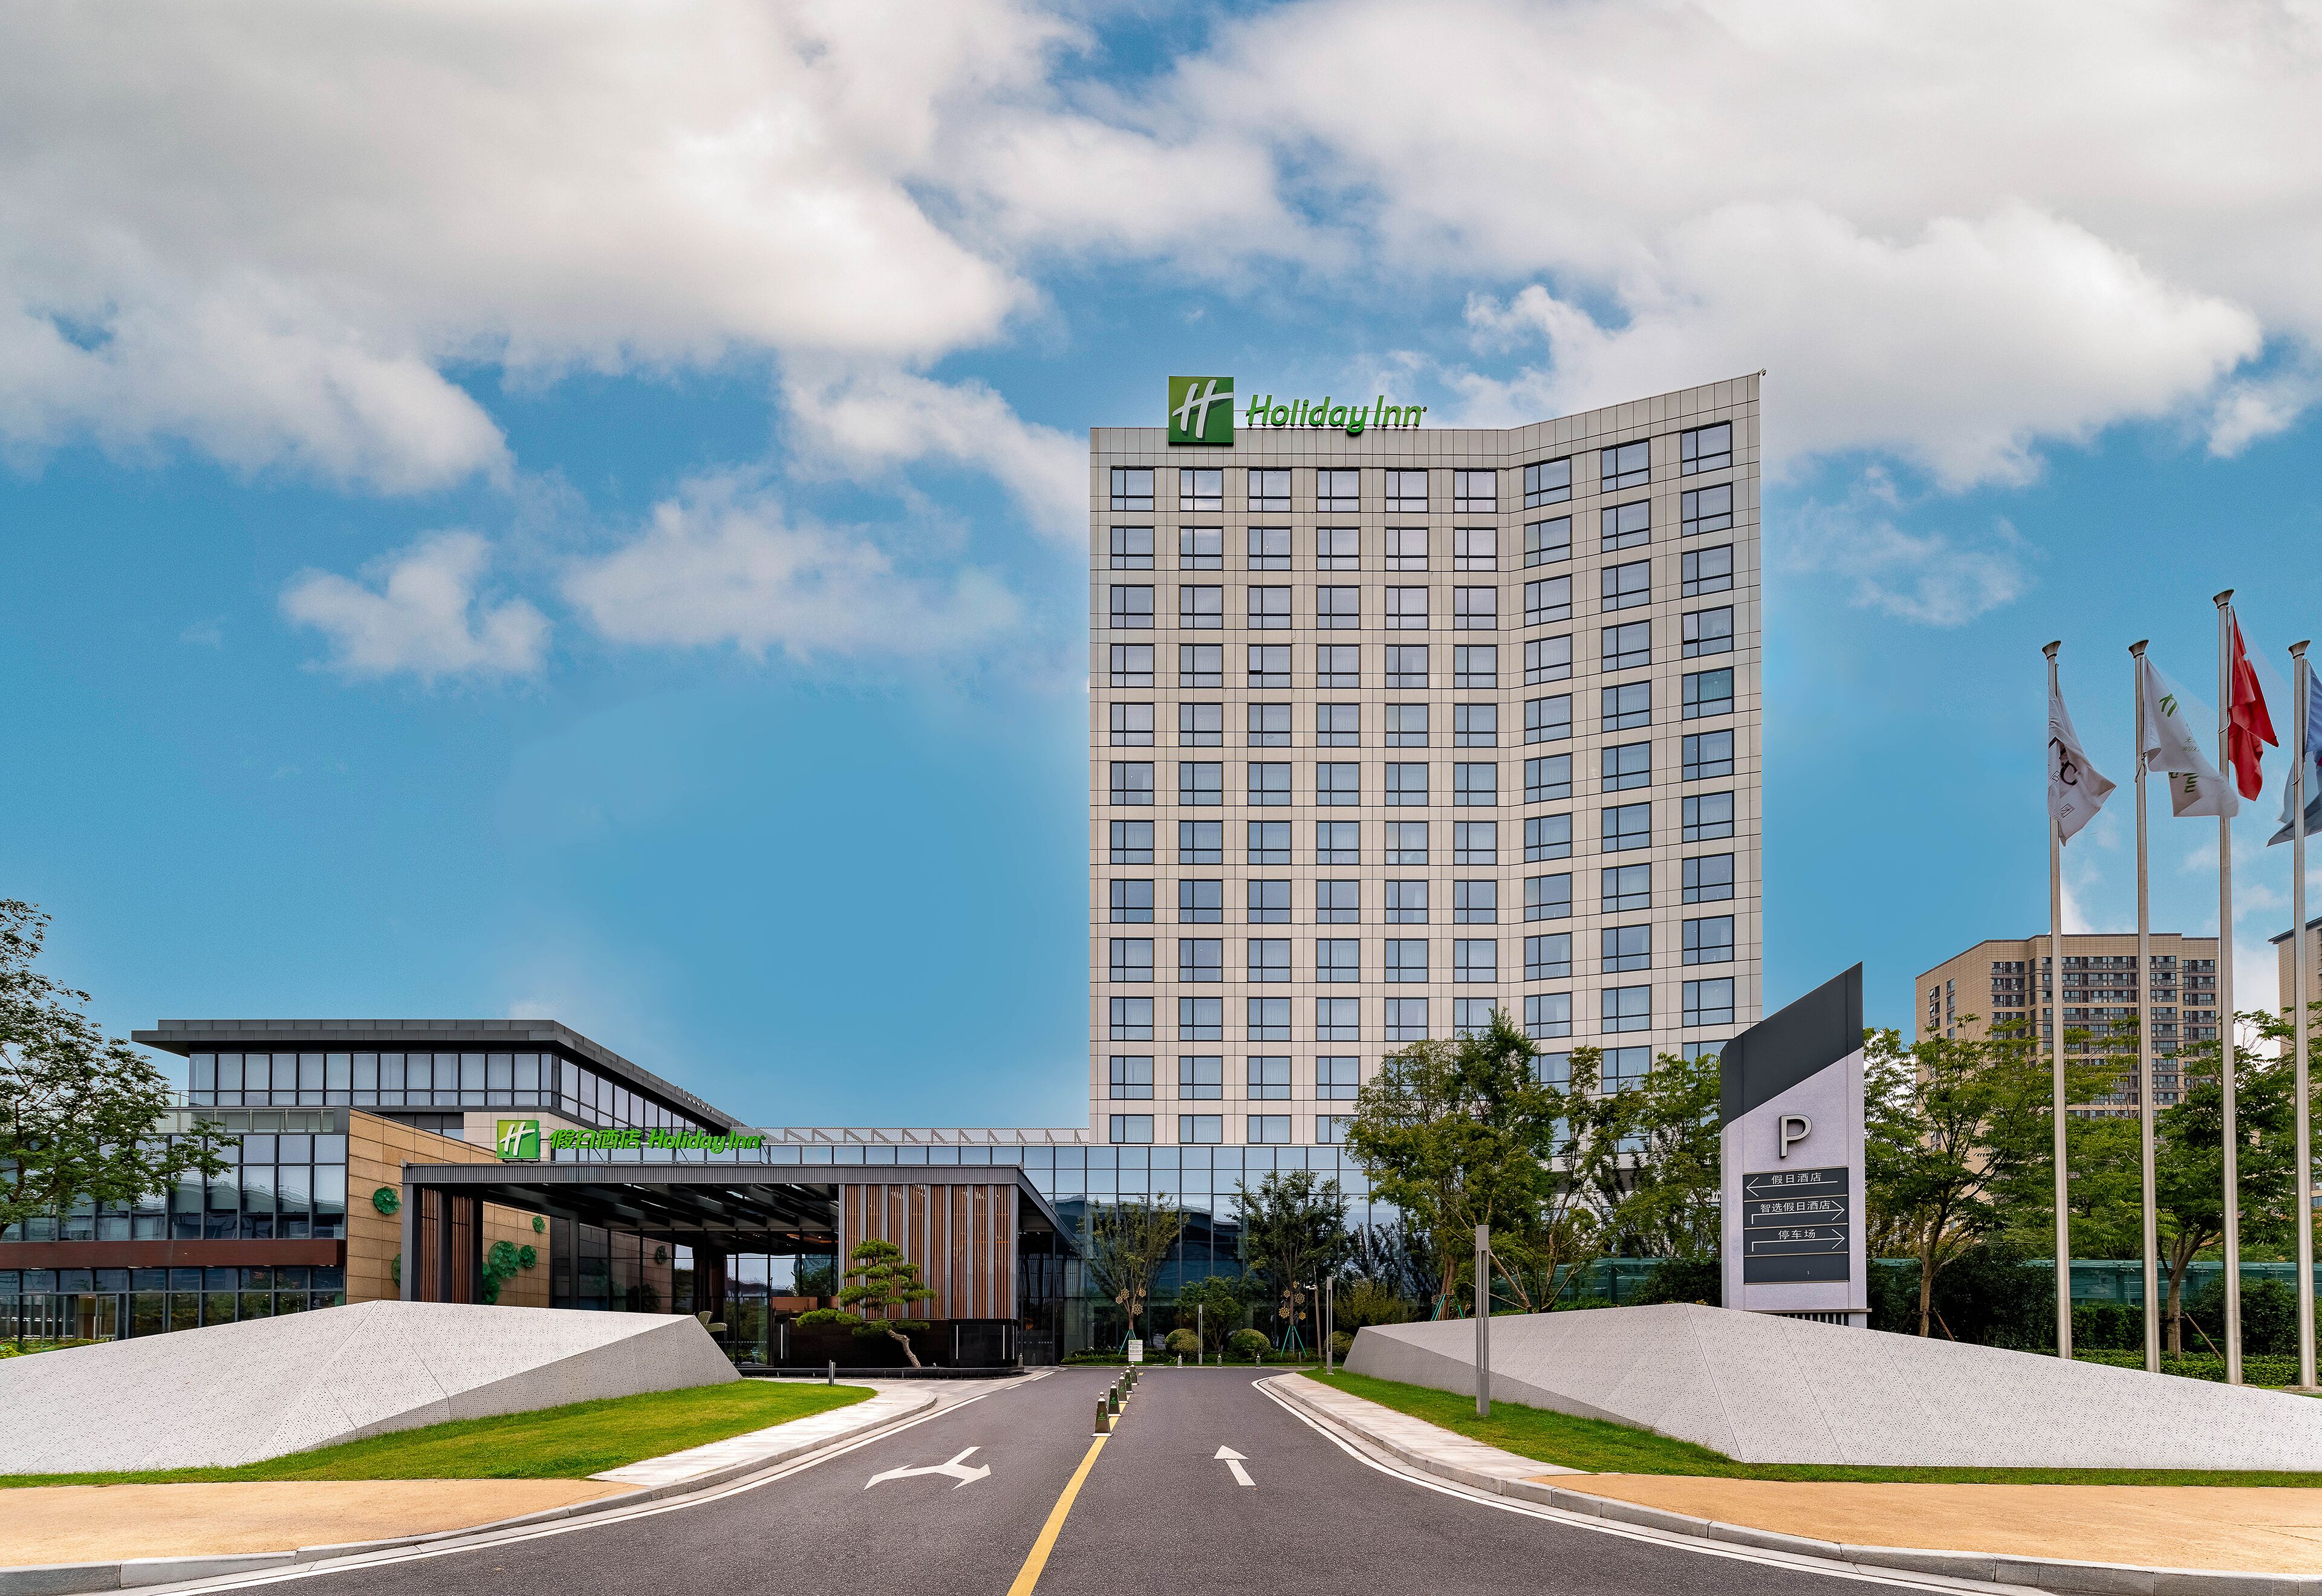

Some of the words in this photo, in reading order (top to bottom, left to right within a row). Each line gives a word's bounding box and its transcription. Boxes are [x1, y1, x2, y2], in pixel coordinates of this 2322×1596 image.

[1246, 394, 1367, 436] Holiday
[1373, 395, 1423, 428] Inn
[548, 1129, 642, 1150] 假日酒店
[648, 1129, 726, 1154] Holiday
[728, 1130, 762, 1150] Inn
[1778, 1114, 1812, 1158] P
[1771, 1172, 1821, 1185] 假日酒店
[1760, 1200, 1830, 1213] 智选假日酒店
[1778, 1229, 1815, 1240] 停车场
